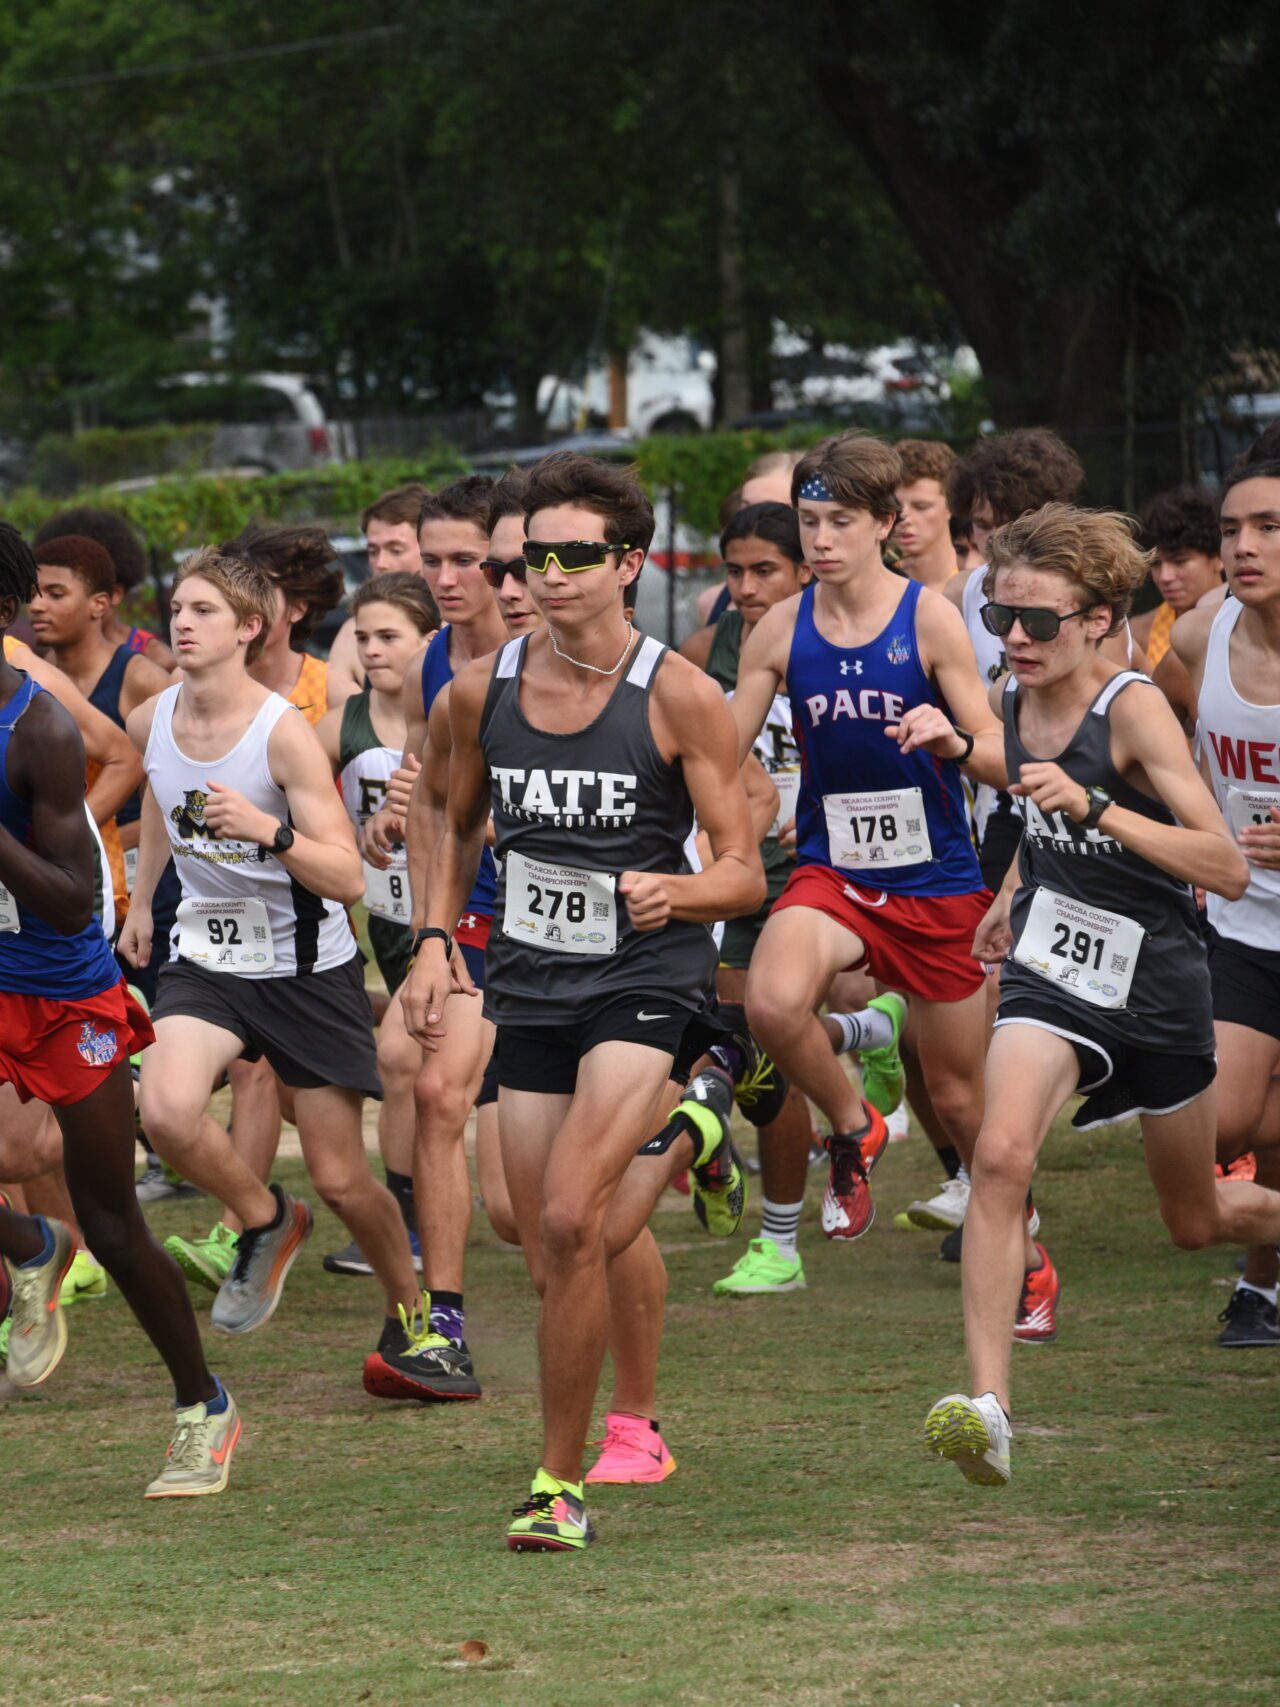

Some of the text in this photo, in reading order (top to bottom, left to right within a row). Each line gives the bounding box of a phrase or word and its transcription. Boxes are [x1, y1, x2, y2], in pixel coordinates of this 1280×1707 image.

[806, 689, 904, 728] PACE
[1208, 731, 1280, 784] WE
[490, 766, 637, 816] TATE
[553, 814, 632, 828] COUNTRY
[850, 814, 898, 844] 178
[559, 869, 592, 881] COUNTY
[527, 882, 586, 924] 278
[1054, 897, 1121, 928] ESCAROSA COUNTY
[206, 918, 242, 945] 92
[1056, 908, 1114, 936] CHAMPIONSHIPS
[1050, 922, 1105, 971] 291
